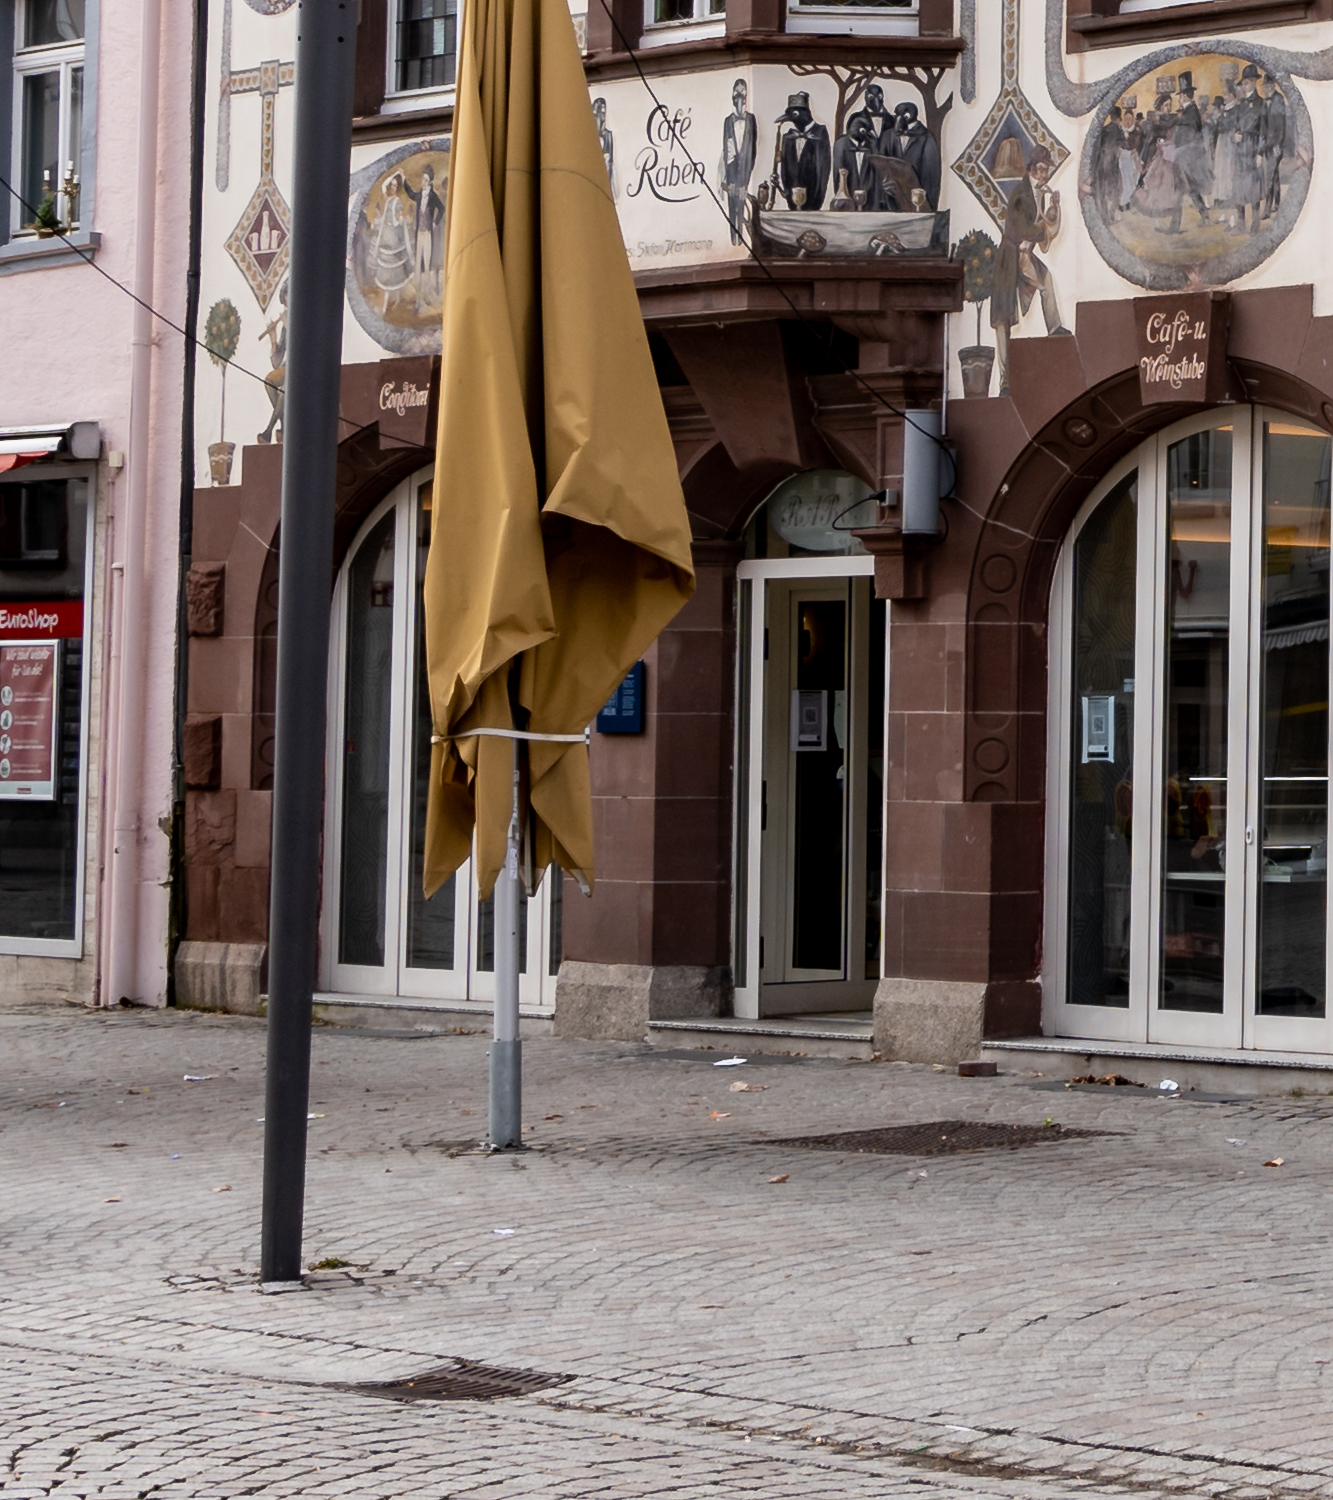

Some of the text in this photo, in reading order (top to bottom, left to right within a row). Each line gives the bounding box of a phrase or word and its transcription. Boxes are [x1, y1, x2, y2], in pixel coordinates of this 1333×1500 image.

[646, 104, 692, 152] Café
[626, 146, 705, 203] Raben
[1141, 352, 1205, 389] Weinstube
[0, 608, 58, 632] EuroShop
